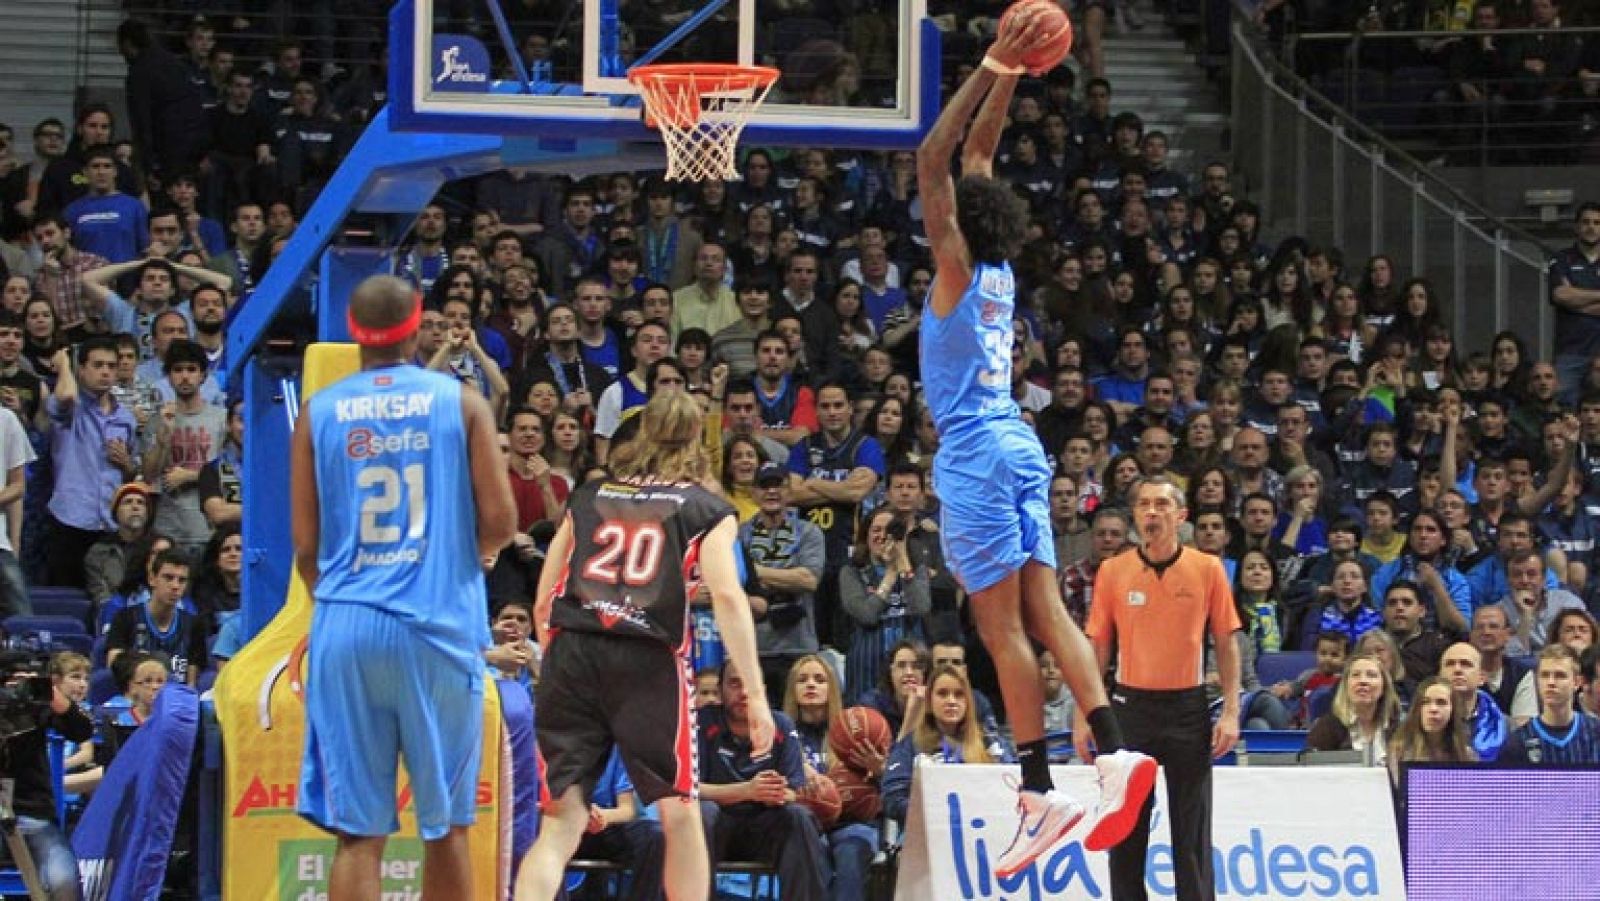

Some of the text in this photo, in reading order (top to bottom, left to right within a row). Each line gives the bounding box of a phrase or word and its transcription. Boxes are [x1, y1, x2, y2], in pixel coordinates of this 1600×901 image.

[336, 393, 434, 421] KIRKSAY
[347, 428, 430, 459] asefa
[358, 464, 427, 543] 21
[583, 519, 666, 586] 20
[299, 854, 324, 880] El
